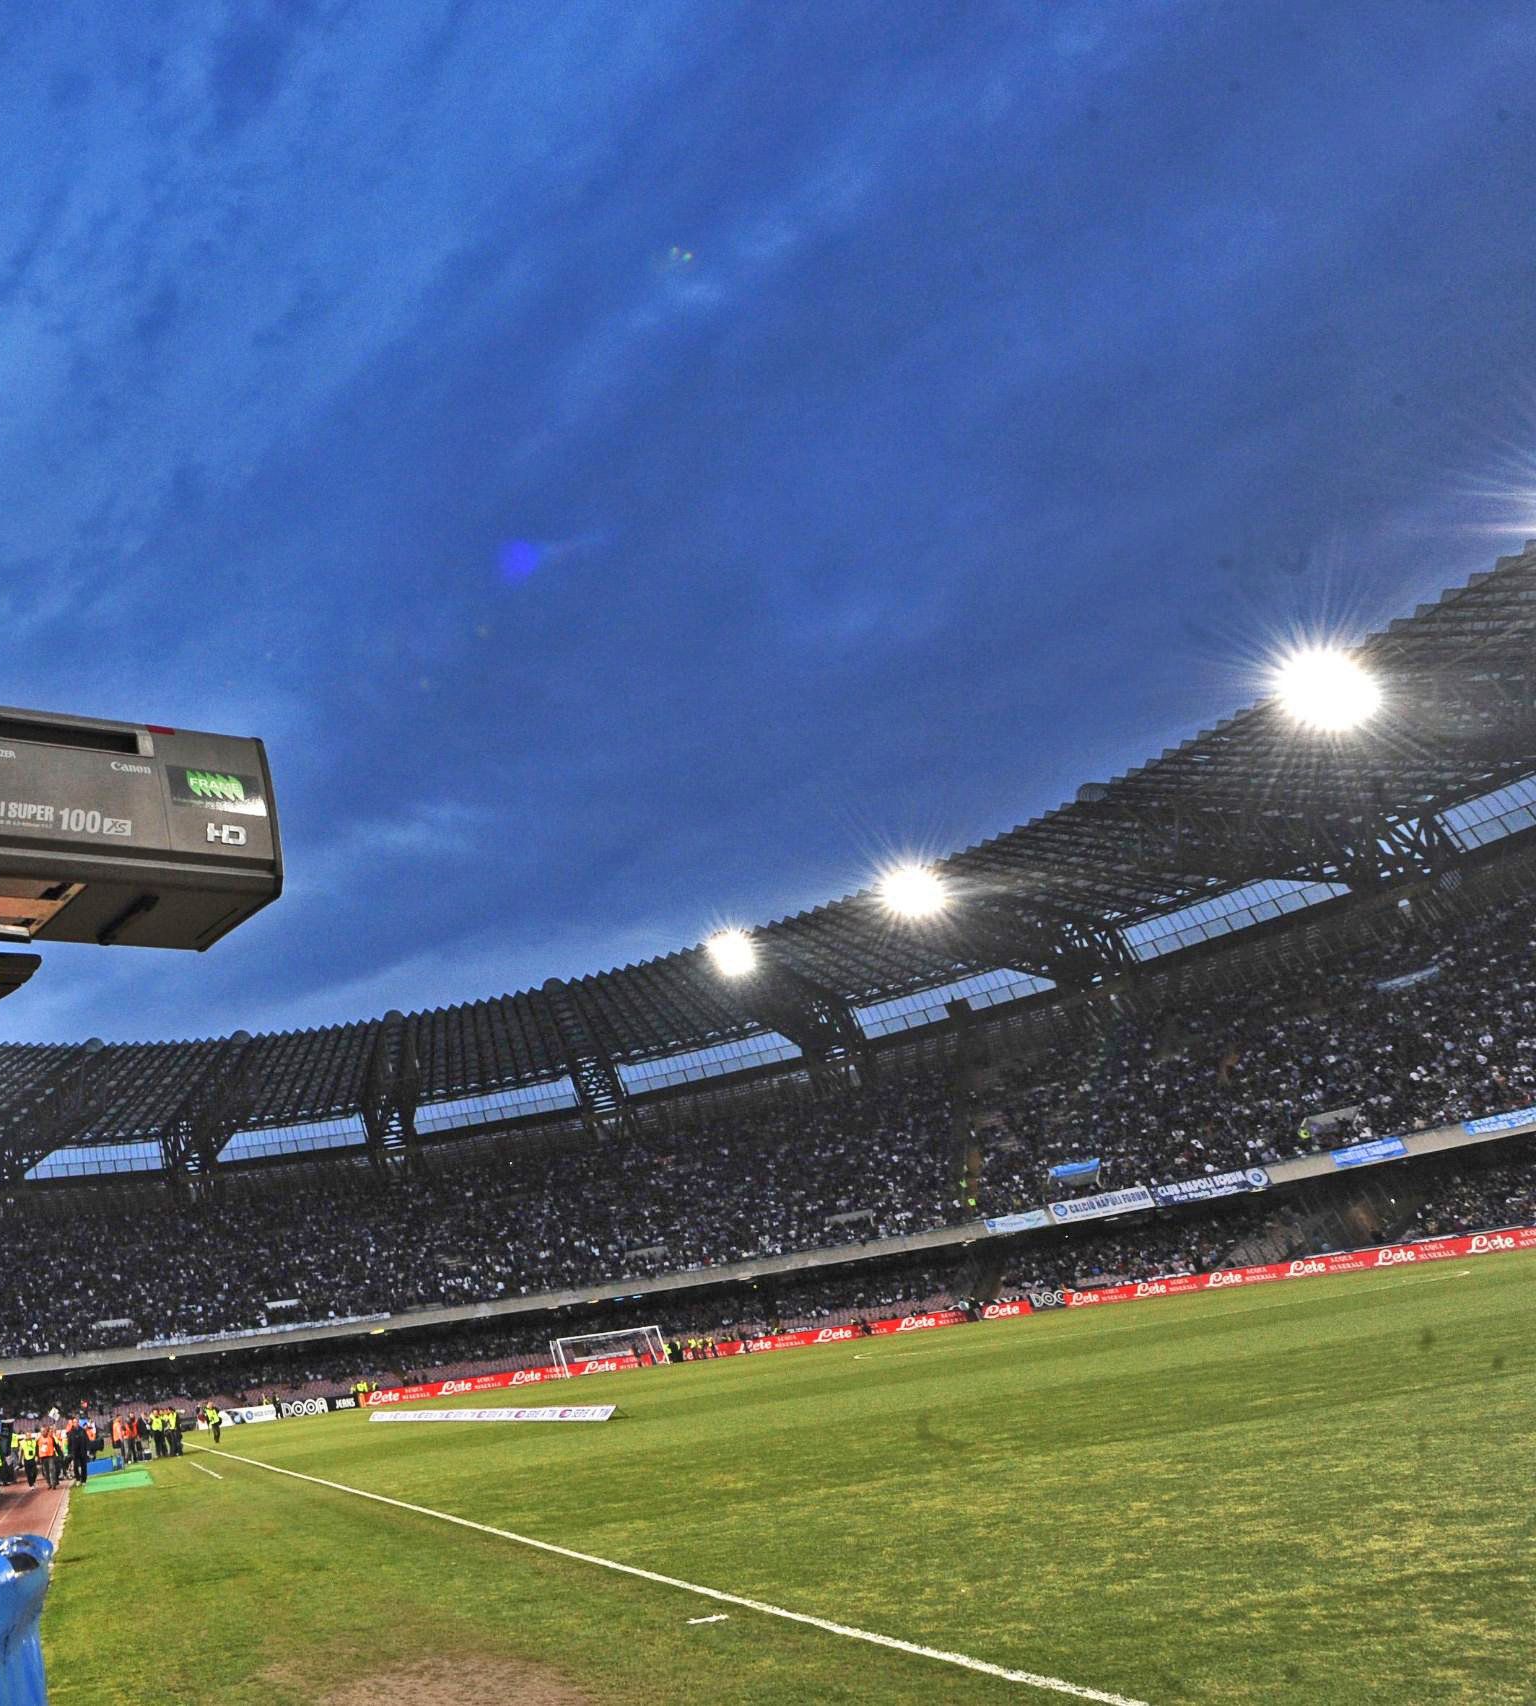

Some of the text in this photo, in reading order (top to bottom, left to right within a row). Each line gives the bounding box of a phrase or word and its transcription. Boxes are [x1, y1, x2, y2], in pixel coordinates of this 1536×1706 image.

[110, 761, 151, 775] Canon
[189, 777, 240, 793] FRAME
[7, 802, 54, 822] SUPER
[59, 807, 101, 834] 100
[206, 822, 247, 846] HD
[1122, 1190, 1150, 1204] FORUM
[1466, 1234, 1515, 1253] Lete
[1374, 1249, 1416, 1266] Lete
[1285, 1260, 1327, 1277] Lete
[1205, 1271, 1242, 1287] Lete
[1134, 1282, 1167, 1297] Lete
[1070, 1292, 1100, 1306] Lete
[983, 1303, 1020, 1319] Lete
[896, 1317, 936, 1331] Lete
[814, 1328, 852, 1343] Lete
[580, 1361, 617, 1375] Lete
[508, 1370, 542, 1384] Lete
[437, 1381, 472, 1395] Lete
[335, 1398, 356, 1409] JEANS
[367, 1390, 400, 1406] Lete
[282, 1398, 329, 1417] DOOA
